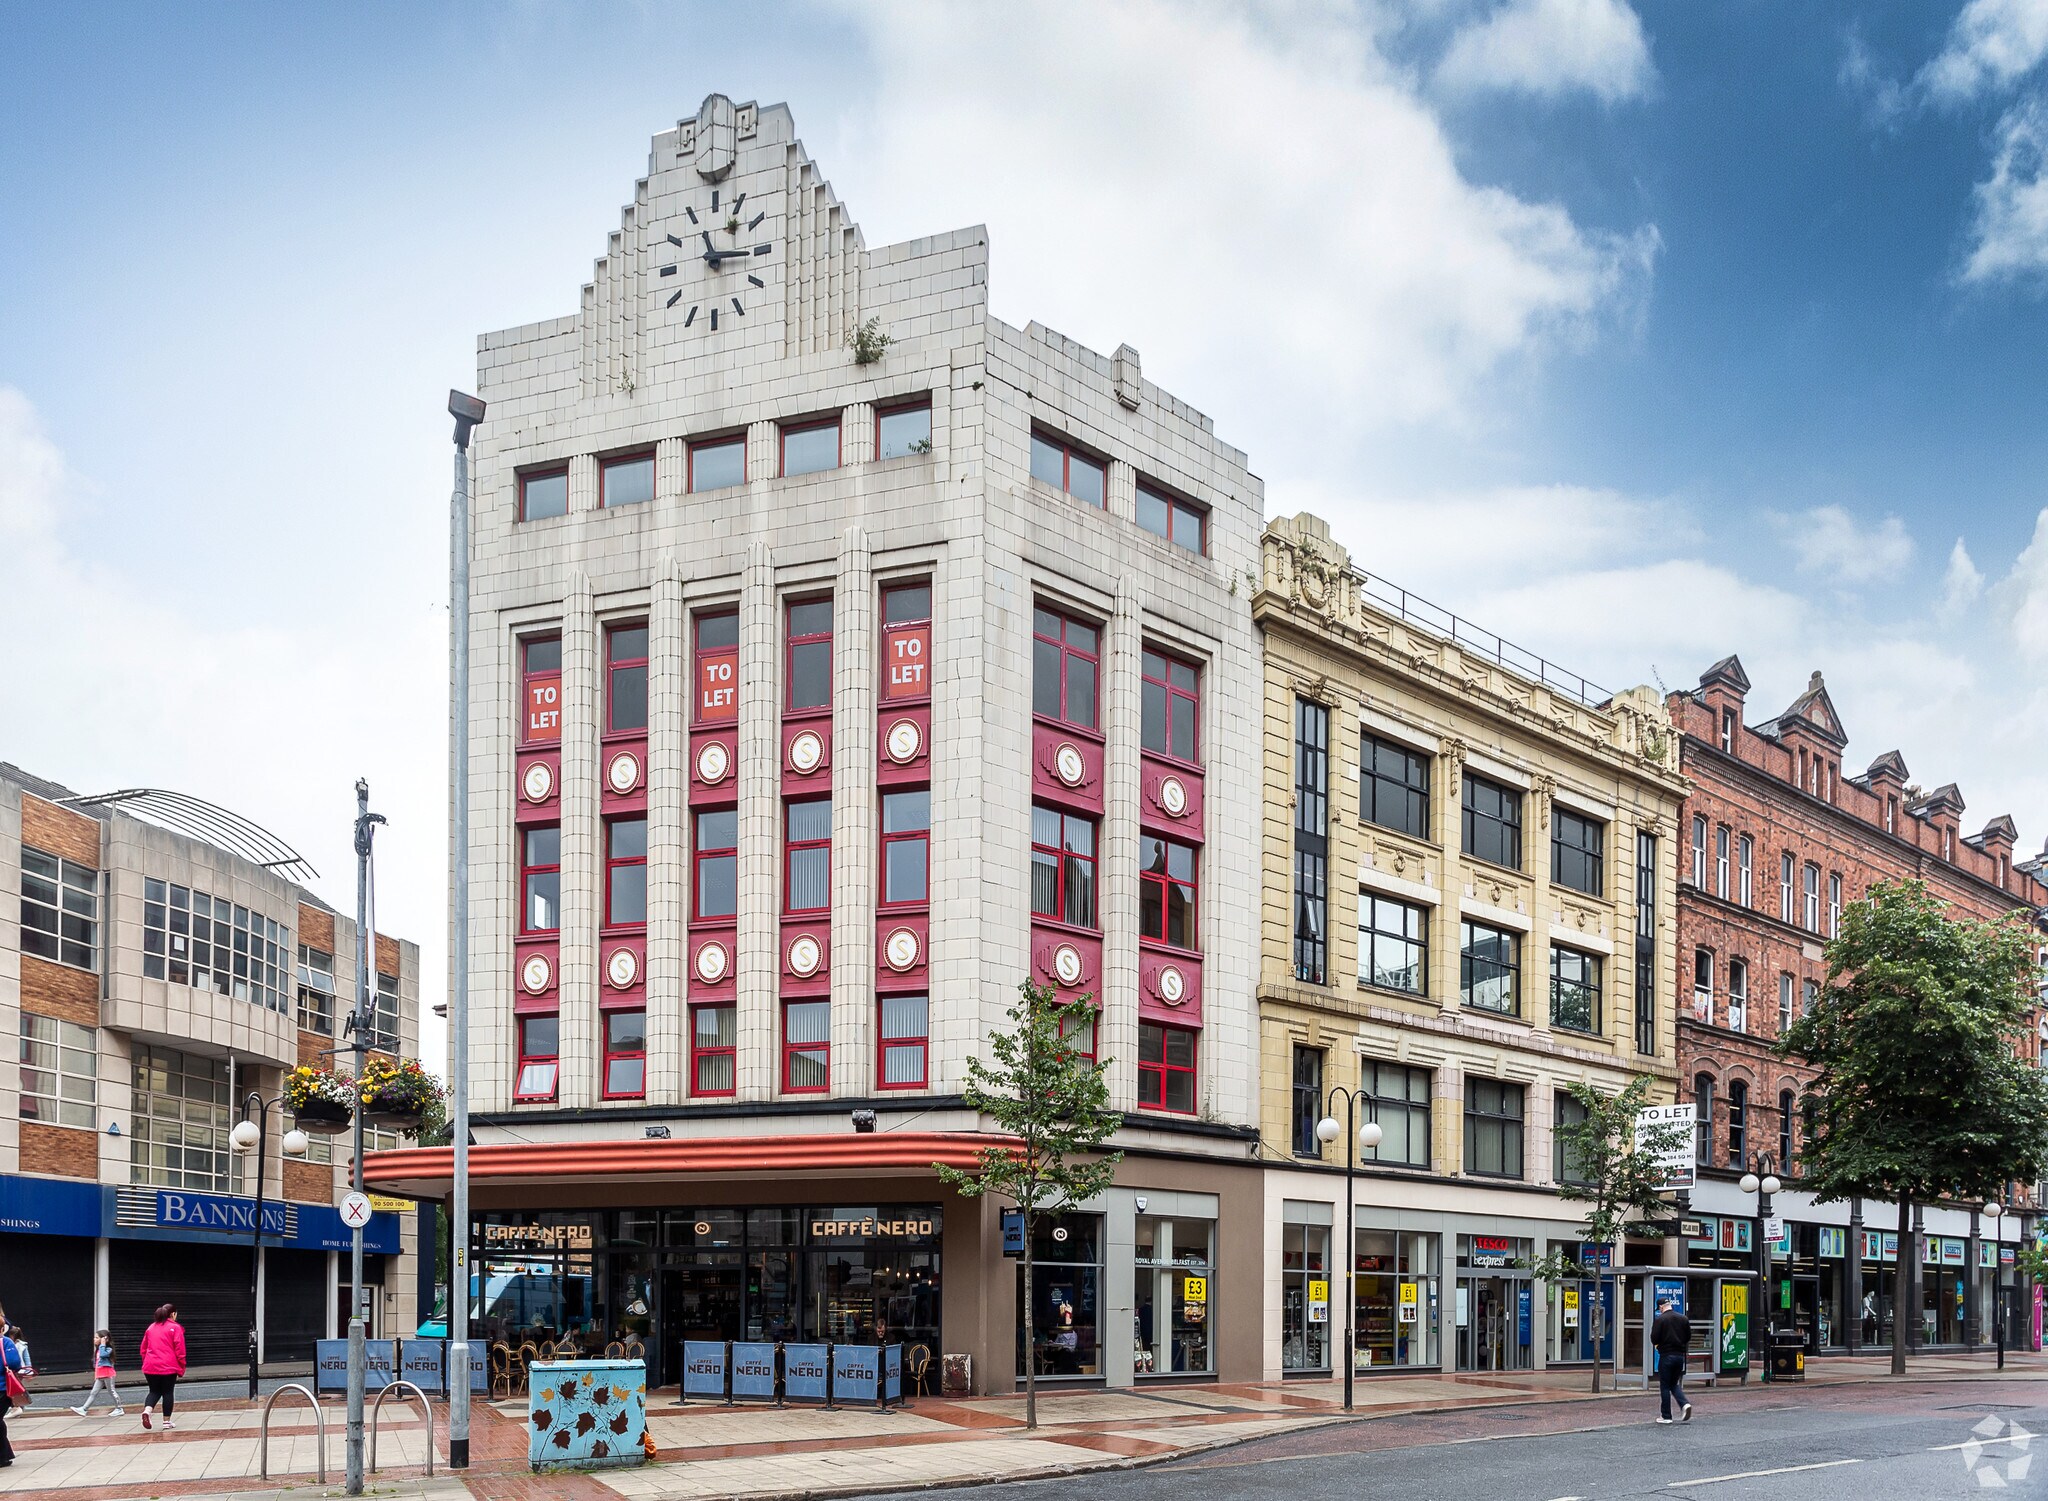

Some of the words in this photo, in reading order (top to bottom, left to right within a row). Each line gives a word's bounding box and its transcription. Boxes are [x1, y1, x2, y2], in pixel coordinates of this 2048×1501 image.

[894, 638, 922, 658] TO
[706, 663, 732, 682] TO
[891, 663, 925, 684] LET
[533, 687, 557, 705] TO
[704, 688, 734, 708] LET
[531, 711, 559, 730] LET
[899, 731, 910, 752] S
[802, 742, 812, 764] S
[708, 753, 719, 774] S
[1065, 754, 1075, 776] S
[533, 773, 543, 792] S
[618, 763, 630, 784] S
[1169, 786, 1178, 808] S
[800, 945, 812, 967] S
[898, 938, 909, 960] S
[618, 958, 628, 978] S
[706, 952, 718, 974] S
[1064, 954, 1074, 976] S
[531, 964, 542, 984] S
[1168, 975, 1177, 996] S
[1641, 1110, 1660, 1120] TO
[1664, 1107, 1691, 1118] LET
[543, 1226, 591, 1239] NERO
[812, 1216, 873, 1236] CAFFÈ
[876, 1220, 933, 1236] NERO
[1476, 1238, 1508, 1250] TESCO
[1476, 1256, 1506, 1268] express
[1188, 1280, 1202, 1294] £3
[1315, 1286, 1322, 1296] £1
[1405, 1289, 1412, 1298] £1
[1566, 1292, 1577, 1301] Half
[1566, 1300, 1577, 1310] Price
[320, 1362, 347, 1370] NERO
[406, 1362, 438, 1371] NERO
[688, 1364, 721, 1374] NERO
[736, 1366, 771, 1376] NERO
[789, 1367, 823, 1378] NERO
[837, 1369, 874, 1380] NERO
